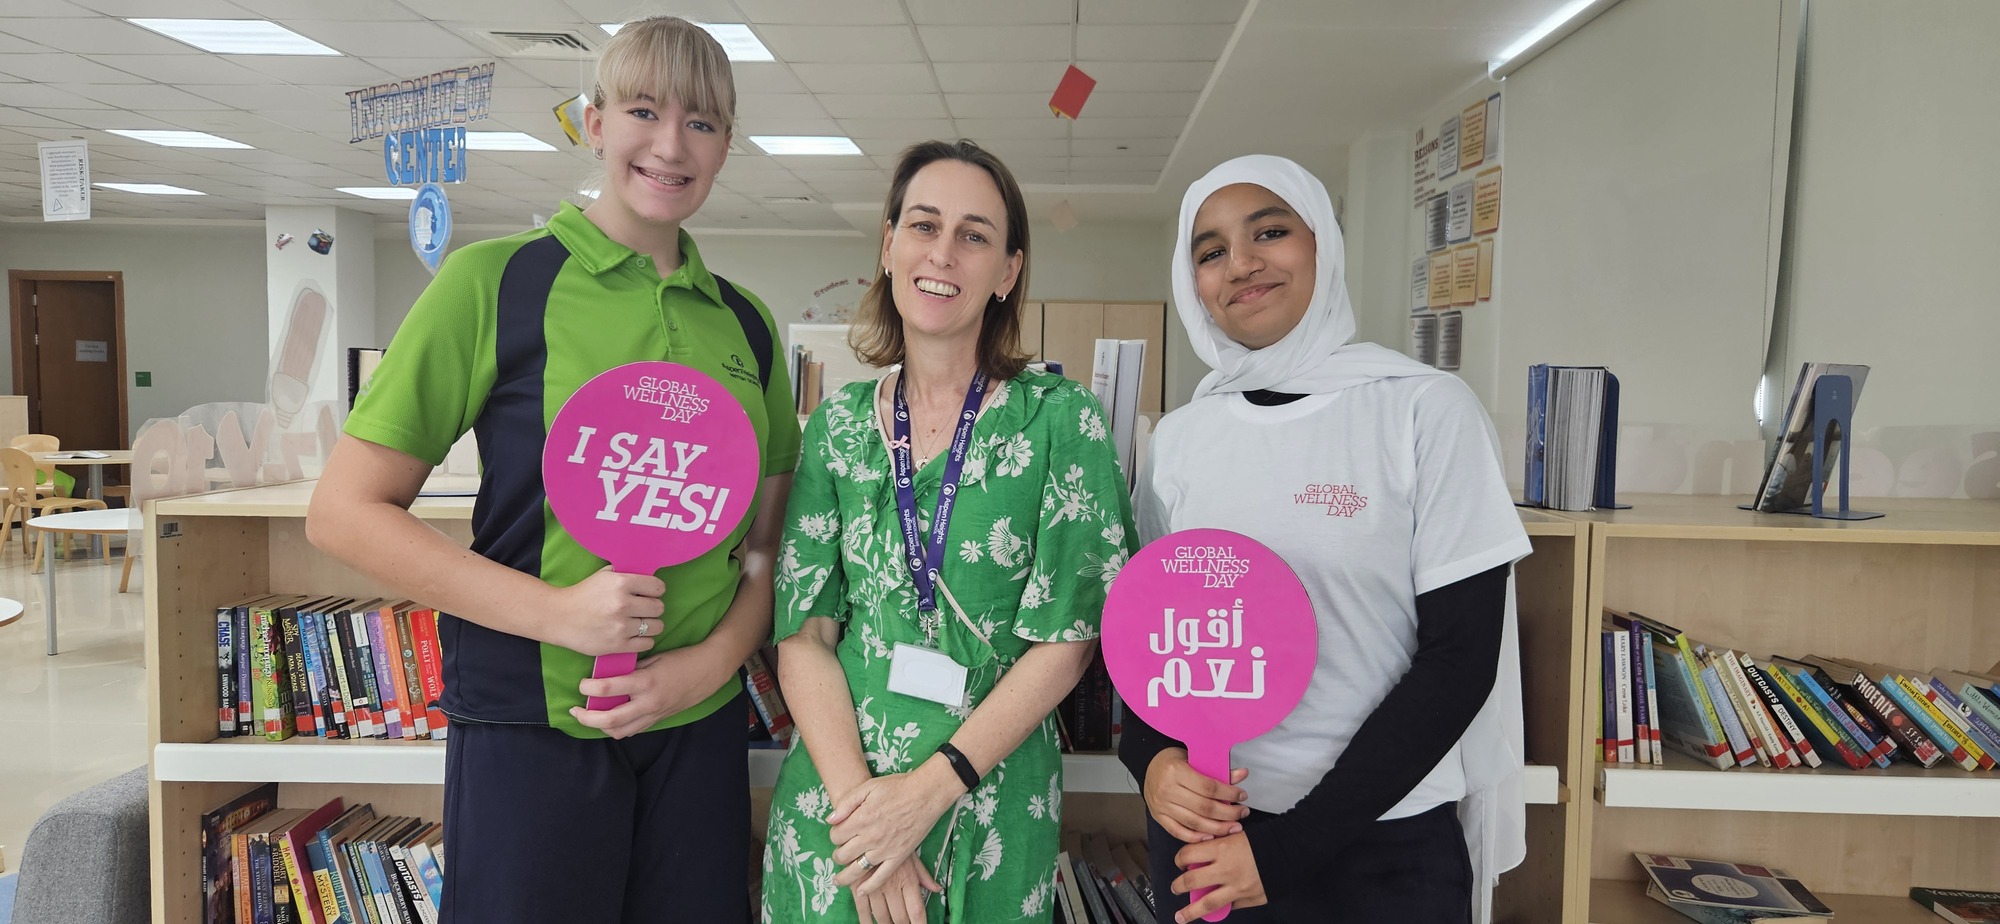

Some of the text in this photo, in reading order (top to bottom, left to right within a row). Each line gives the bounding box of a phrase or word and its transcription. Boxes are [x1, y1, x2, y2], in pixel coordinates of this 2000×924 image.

[345, 62, 495, 143] INFORMATION
[384, 126, 467, 185] CENTER
[1414, 138, 1439, 161] REASONS
[814, 279, 849, 297] Student
[623, 384, 710, 413] WELLNESS
[639, 376, 699, 397] GLOBAL
[660, 407, 698, 424] DAY
[567, 426, 708, 480] I SAY
[955, 422, 971, 462] Aspen Heights
[595, 469, 730, 535] YES!
[1294, 493, 1368, 508] WELLNESS
[1306, 484, 1357, 495] GLOBAL
[903, 508, 913, 535] Heights
[936, 497, 951, 544] Aspen Heights
[1326, 505, 1358, 518] DAY
[1175, 546, 1236, 559] GLOBAL
[1161, 559, 1250, 574] WELLNESS
[1203, 574, 1238, 588] DAY
[219, 621, 231, 647] CHASE
[261, 615, 271, 642] michael
[283, 618, 294, 644] MASTER
[291, 624, 300, 636] SPY
[1149, 598, 1244, 656] أقول
[263, 644, 272, 676] morpurgo
[295, 653, 306, 692] DEADLY STORM
[405, 662, 417, 682] Secrets
[421, 640, 437, 697] POLLY WOLF
[222, 673, 230, 697] LINWOOD
[289, 673, 298, 692] VOYAGE
[338, 666, 346, 683] Heart
[1147, 646, 1267, 708] نعم
[1707, 668, 1719, 683] The
[1726, 653, 1736, 667] THE
[1733, 667, 1752, 698] IMAGINARY
[1747, 666, 1779, 705] OUTCASTS
[1772, 671, 1792, 692] HATTIE
[1078, 684, 1085, 695] OF
[1712, 682, 1733, 716] Elephant
[1851, 672, 1896, 719] PHOENIX
[1964, 686, 1985, 705] Little
[1777, 707, 1796, 732] DESTINY
[1826, 699, 1848, 723] AUDACITY
[1895, 688, 1905, 698] THE
[1902, 695, 1922, 715] SEVENTH
[1919, 711, 1933, 725] MOST
[1929, 722, 1954, 747] IMPORTANT
[1905, 727, 1918, 740] S F
[1973, 716, 2000, 746] SUPERFUDGE
[238, 839, 248, 890] JUDY BLUME
[282, 847, 294, 869] HATTIE
[351, 857, 360, 870] STORIES
[358, 878, 366, 894] HEROES
[395, 861, 422, 899] OUTCASTS
[316, 875, 332, 916] MYSTERY
[325, 882, 334, 904] LONDON
[391, 873, 407, 909] BLACKBERRY
